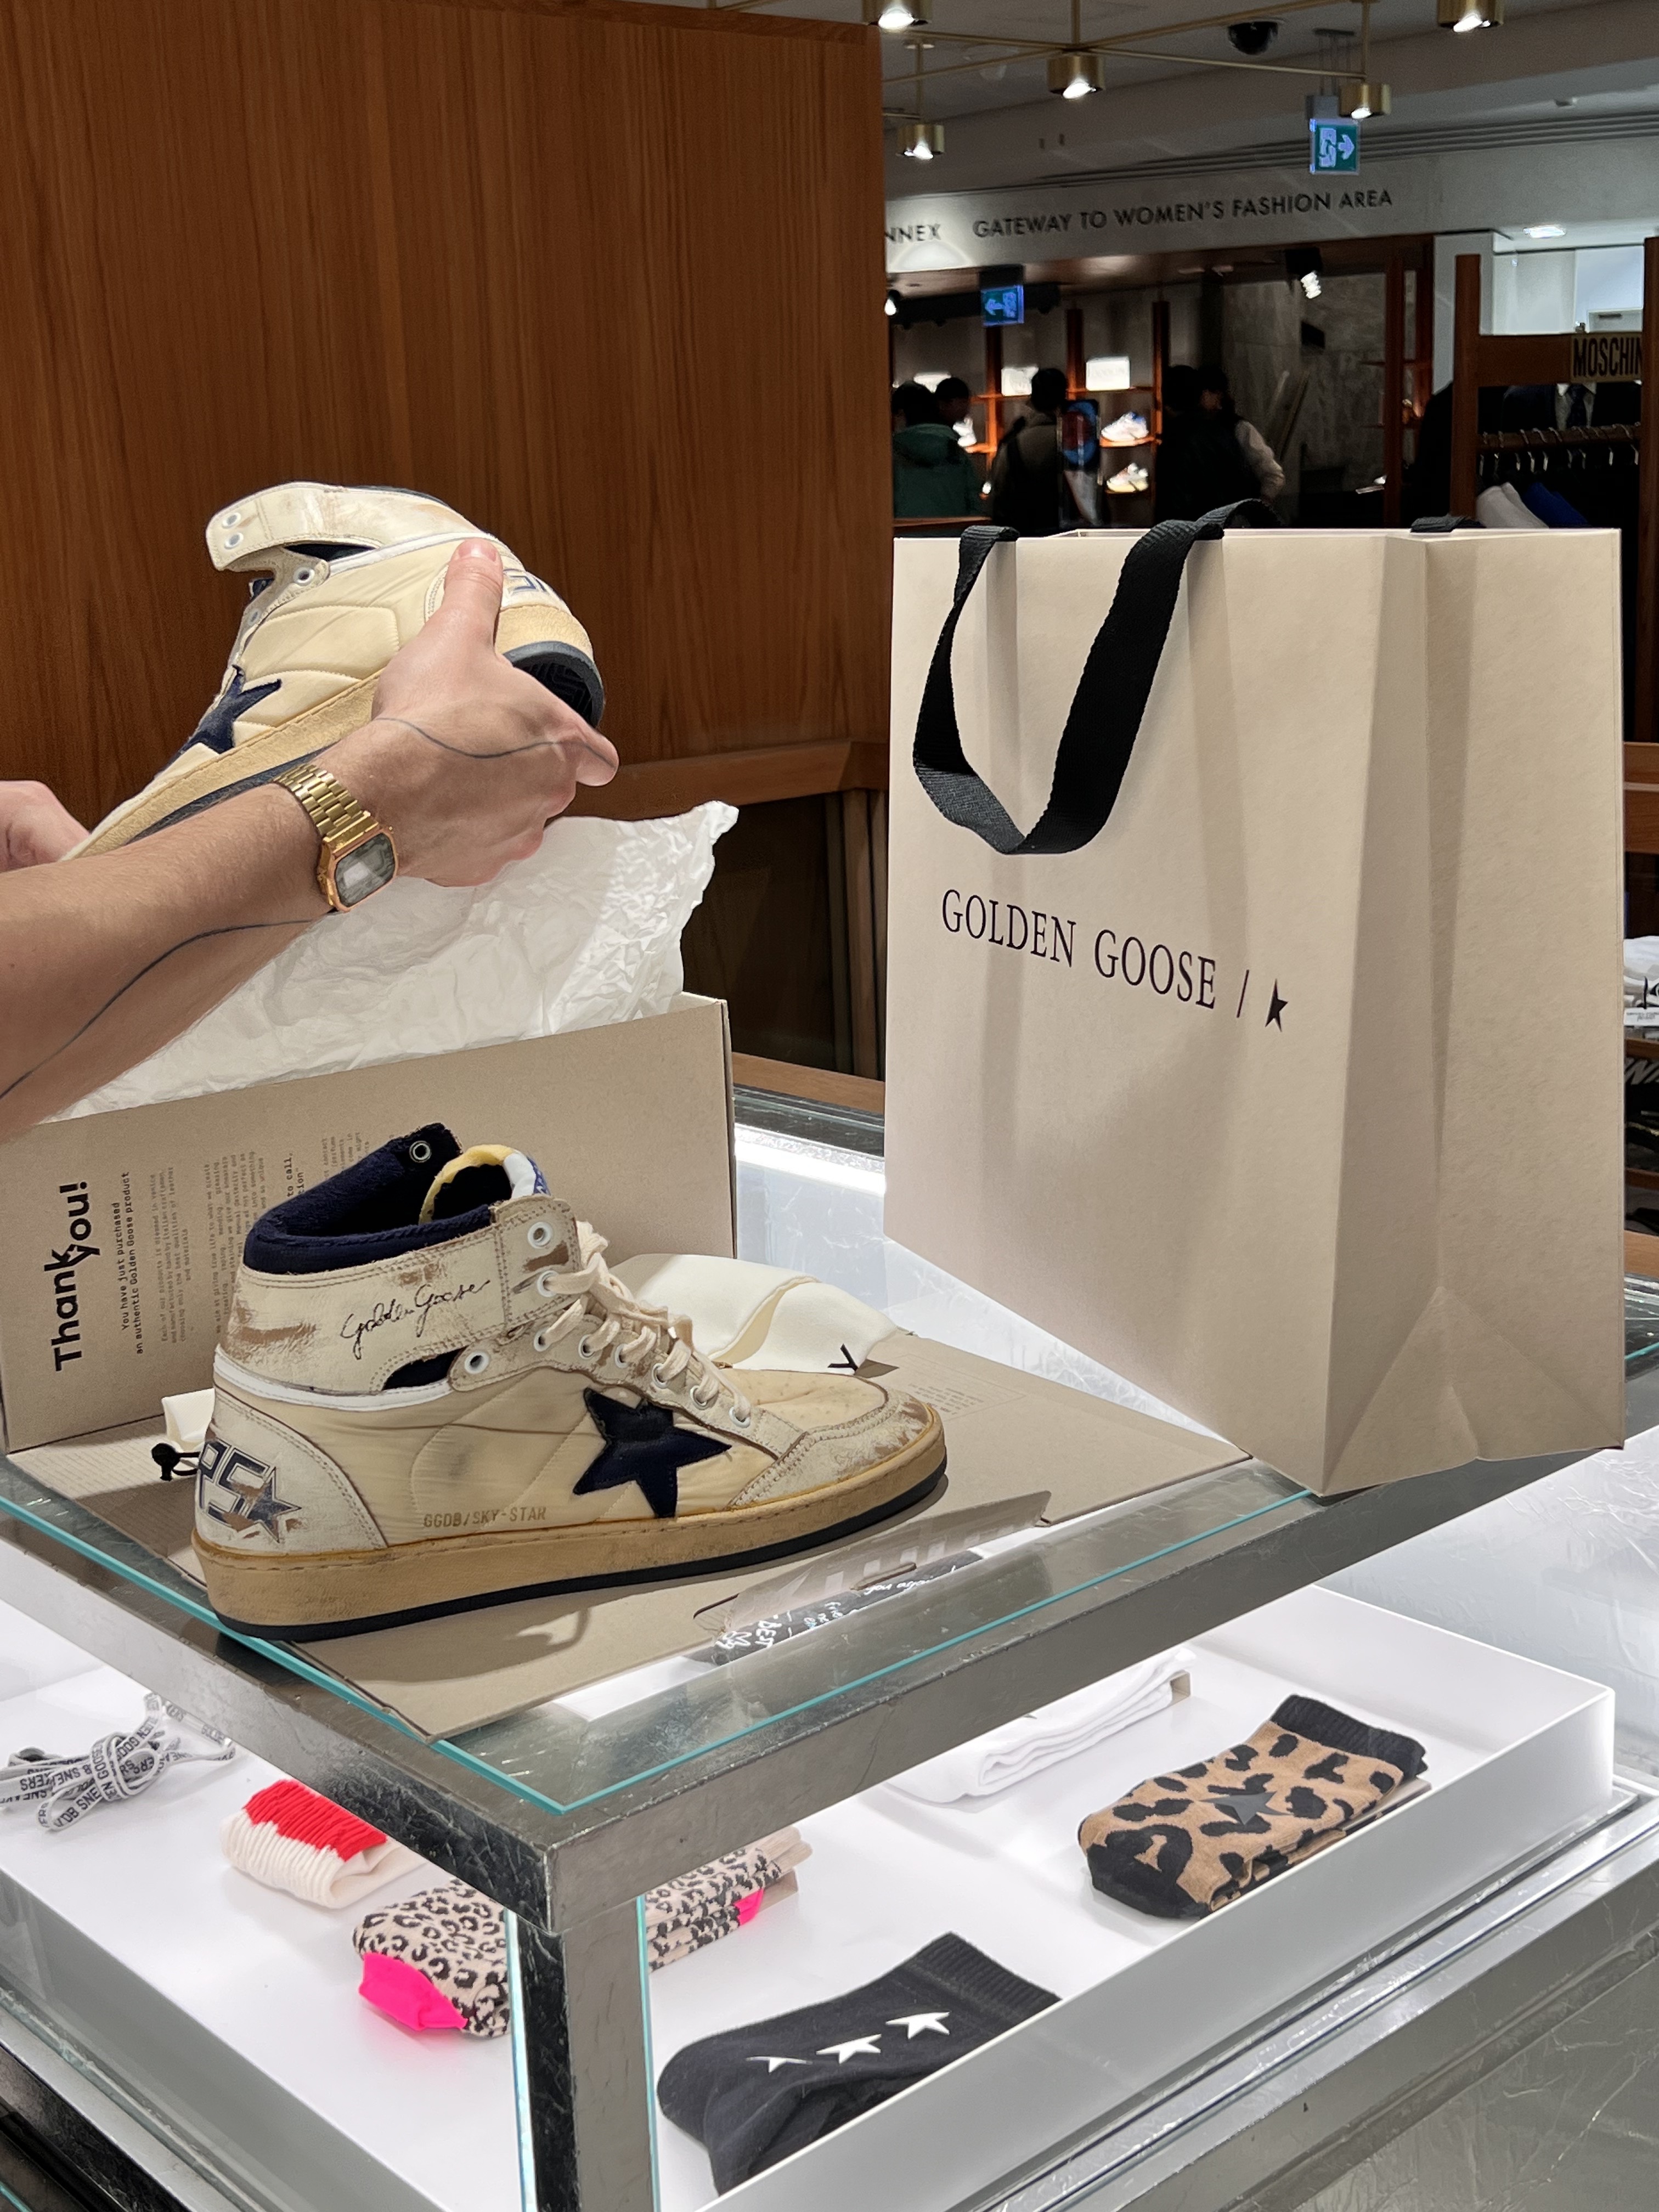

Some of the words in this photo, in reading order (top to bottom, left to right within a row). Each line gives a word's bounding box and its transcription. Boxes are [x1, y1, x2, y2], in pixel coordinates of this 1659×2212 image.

[972, 213, 1072, 238] GATEWAY
[1080, 210, 1107, 229] TO
[1113, 200, 1224, 227] WOMEN'S
[1232, 191, 1331, 217] FASHION
[1339, 189, 1392, 210] AREA
[942, 889, 1076, 968] GOLDEN
[1094, 929, 1216, 1009] GOOSE
[121, 1172, 133, 1213] product
[286, 1185, 294, 1197] to
[111, 1203, 125, 1255] purchased
[125, 1217, 134, 1246] Goose
[116, 1259, 128, 1282] just
[127, 1249, 138, 1285] Golden
[119, 1285, 128, 1309] have
[131, 1288, 142, 1339] authentic
[121, 1312, 129, 1330] You
[340, 1298, 415, 1360] Golden
[414, 1279, 490, 1338] Goose
[136, 1342, 143, 1355] an
